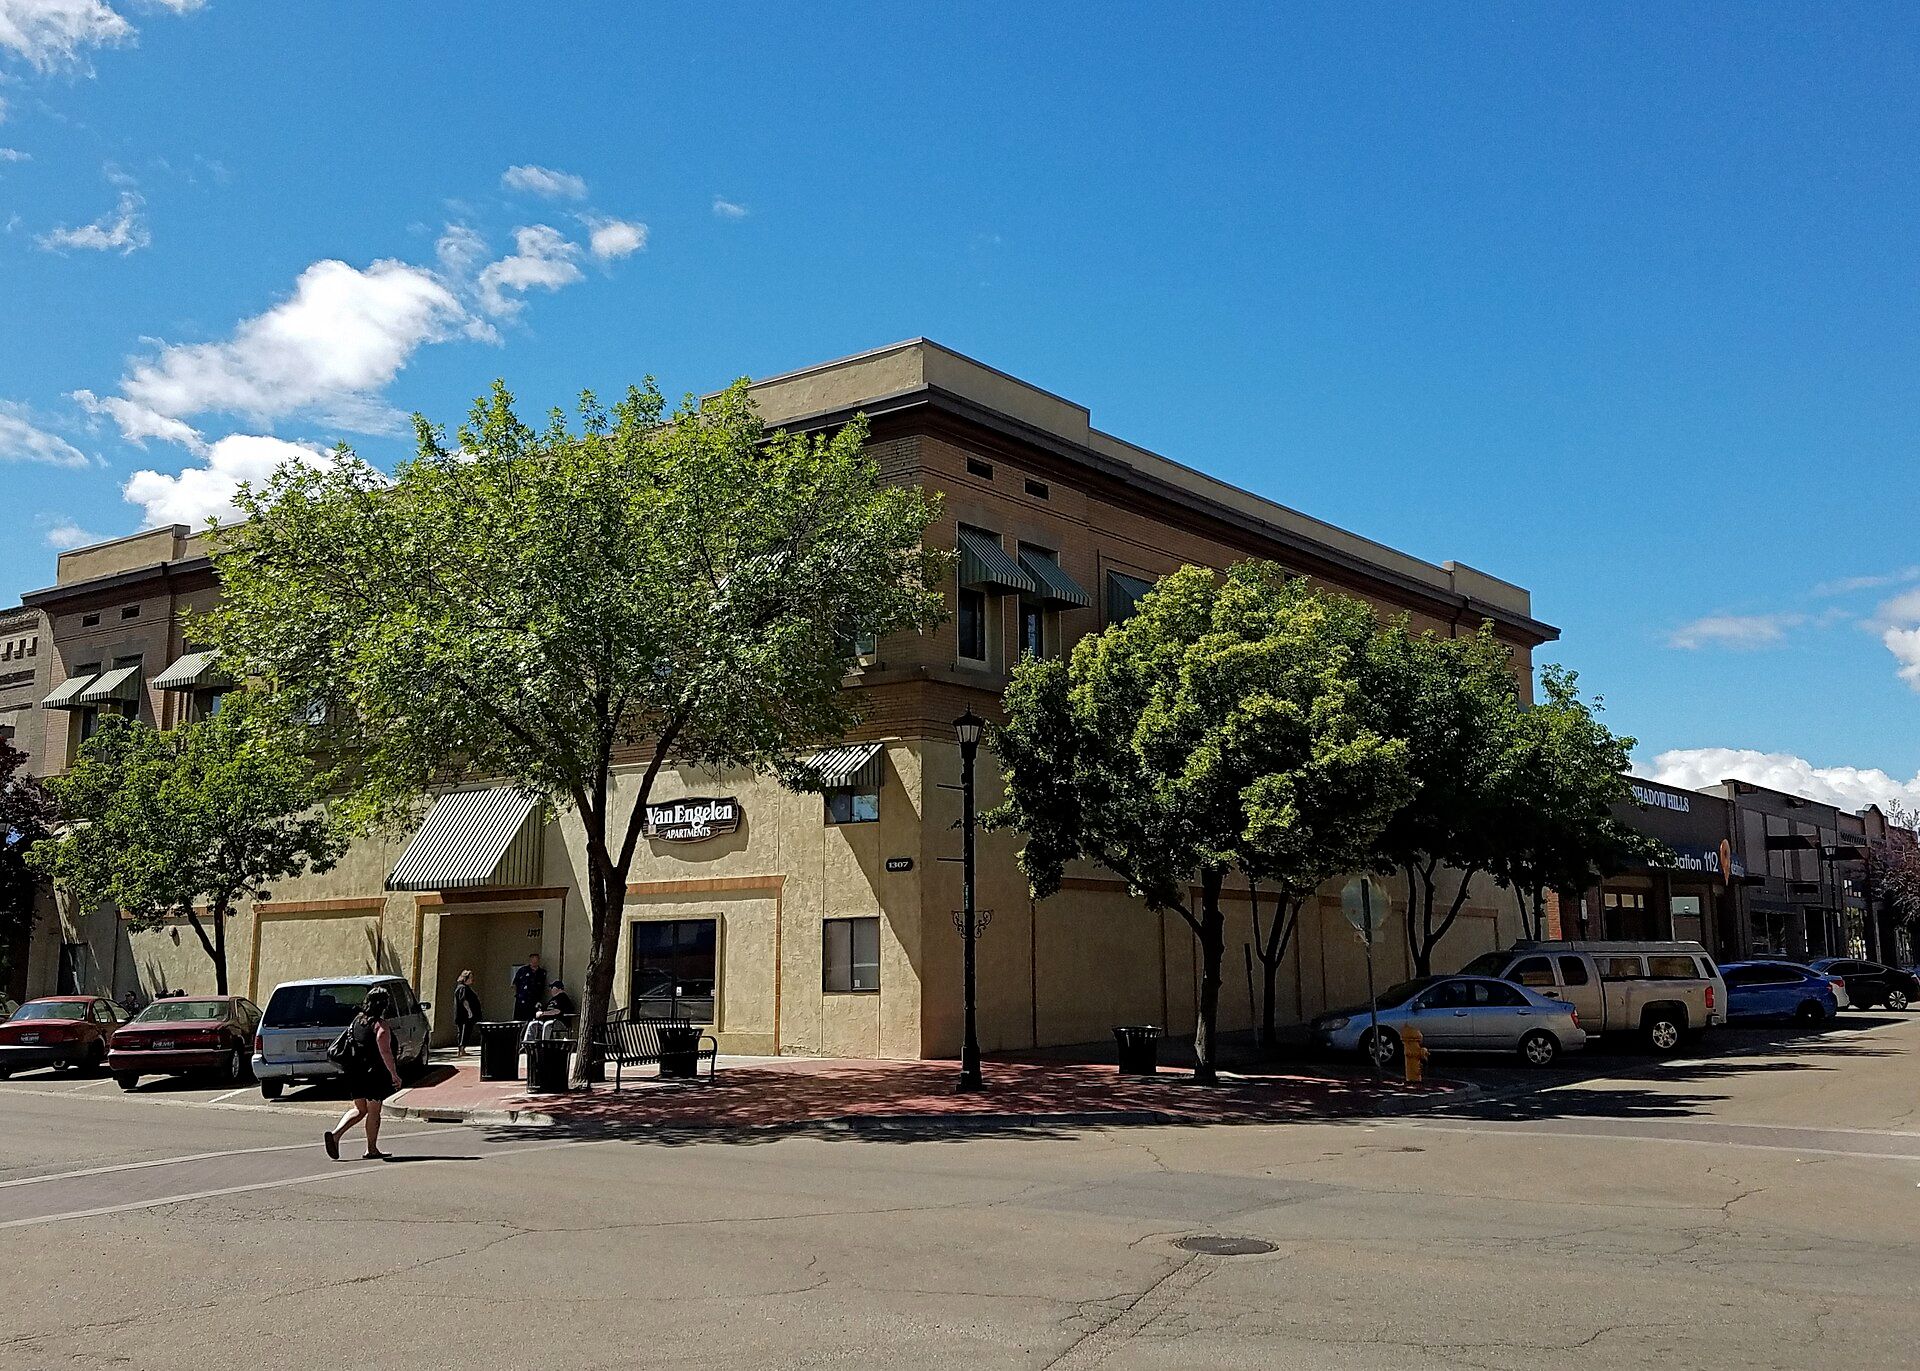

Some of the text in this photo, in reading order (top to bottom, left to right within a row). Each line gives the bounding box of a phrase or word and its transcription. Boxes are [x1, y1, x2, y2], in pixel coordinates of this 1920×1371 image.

[1632, 785, 1690, 813] SHADOW HILLS
[646, 801, 732, 829] Van Engelen
[665, 827, 711, 839] APARTMENTS
[888, 861, 909, 869] 1307
[1704, 851, 1719, 872] 112
